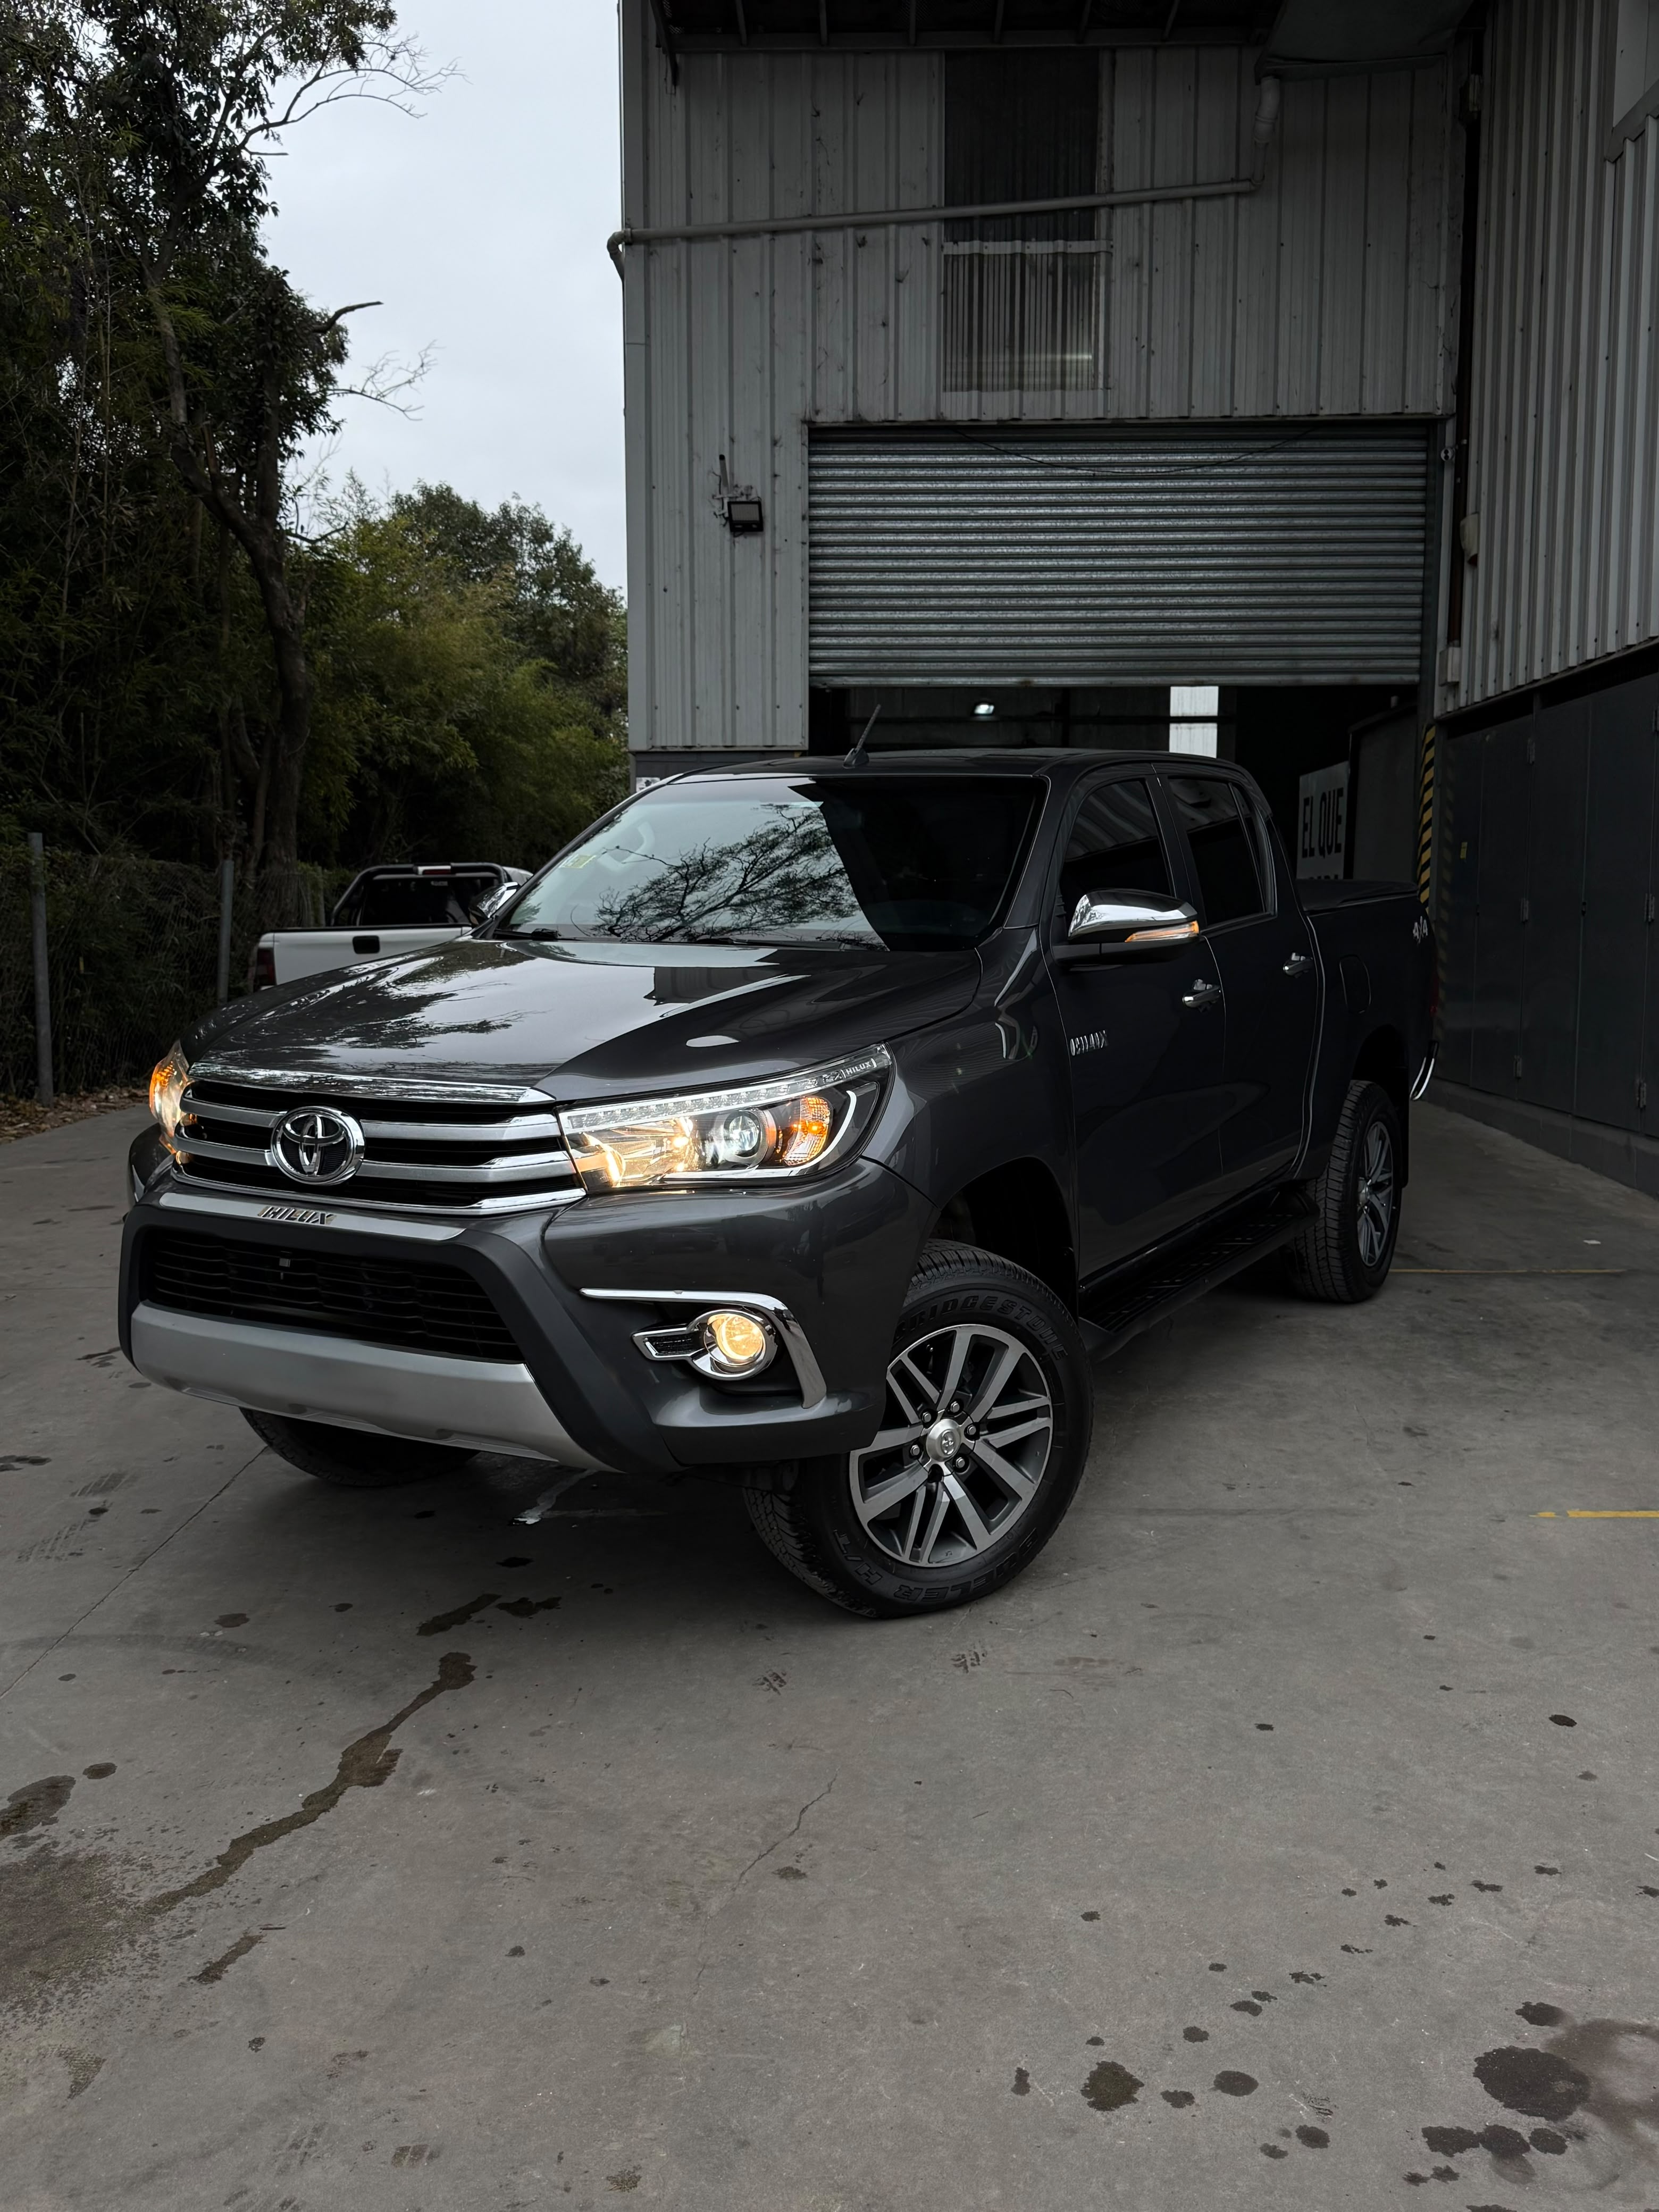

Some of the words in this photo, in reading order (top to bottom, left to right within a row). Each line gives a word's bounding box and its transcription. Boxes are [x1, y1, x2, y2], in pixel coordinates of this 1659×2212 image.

[1302, 795, 1314, 858] EL
[1319, 787, 1343, 859] QUE
[846, 1061, 872, 1075] HILUX
[258, 1205, 336, 1225] HILUX
